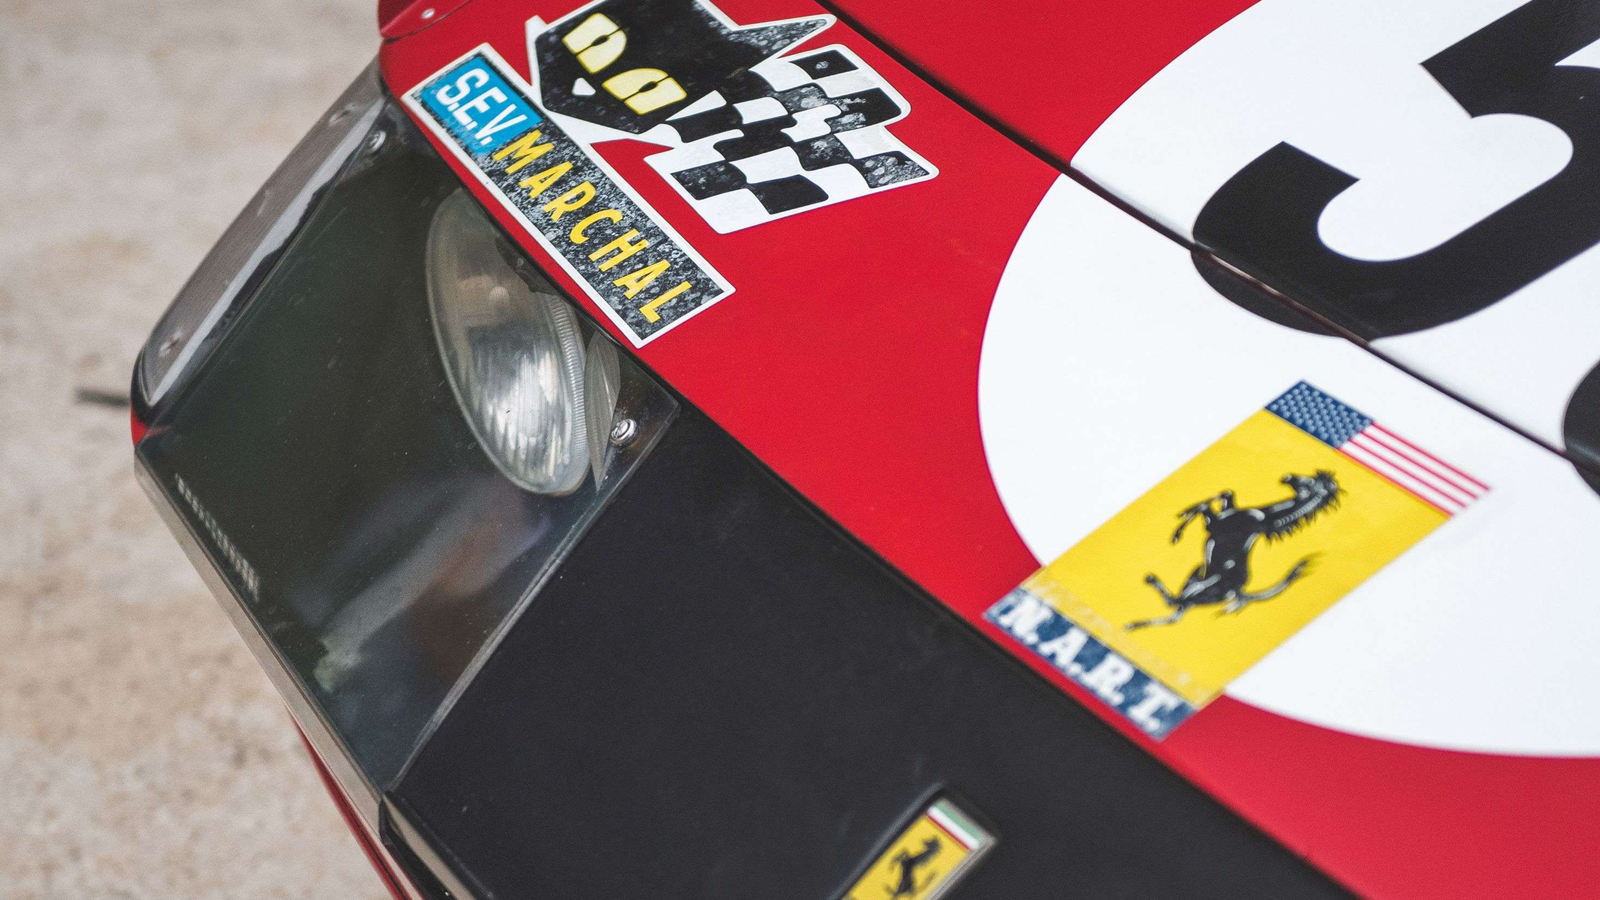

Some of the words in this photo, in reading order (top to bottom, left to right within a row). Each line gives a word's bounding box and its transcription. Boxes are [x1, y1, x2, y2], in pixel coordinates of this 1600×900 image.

[493, 129, 694, 323] MARCHAL
[1191, 0, 1600, 500] 5
[999, 597, 1182, 730] N.A.R.T.
